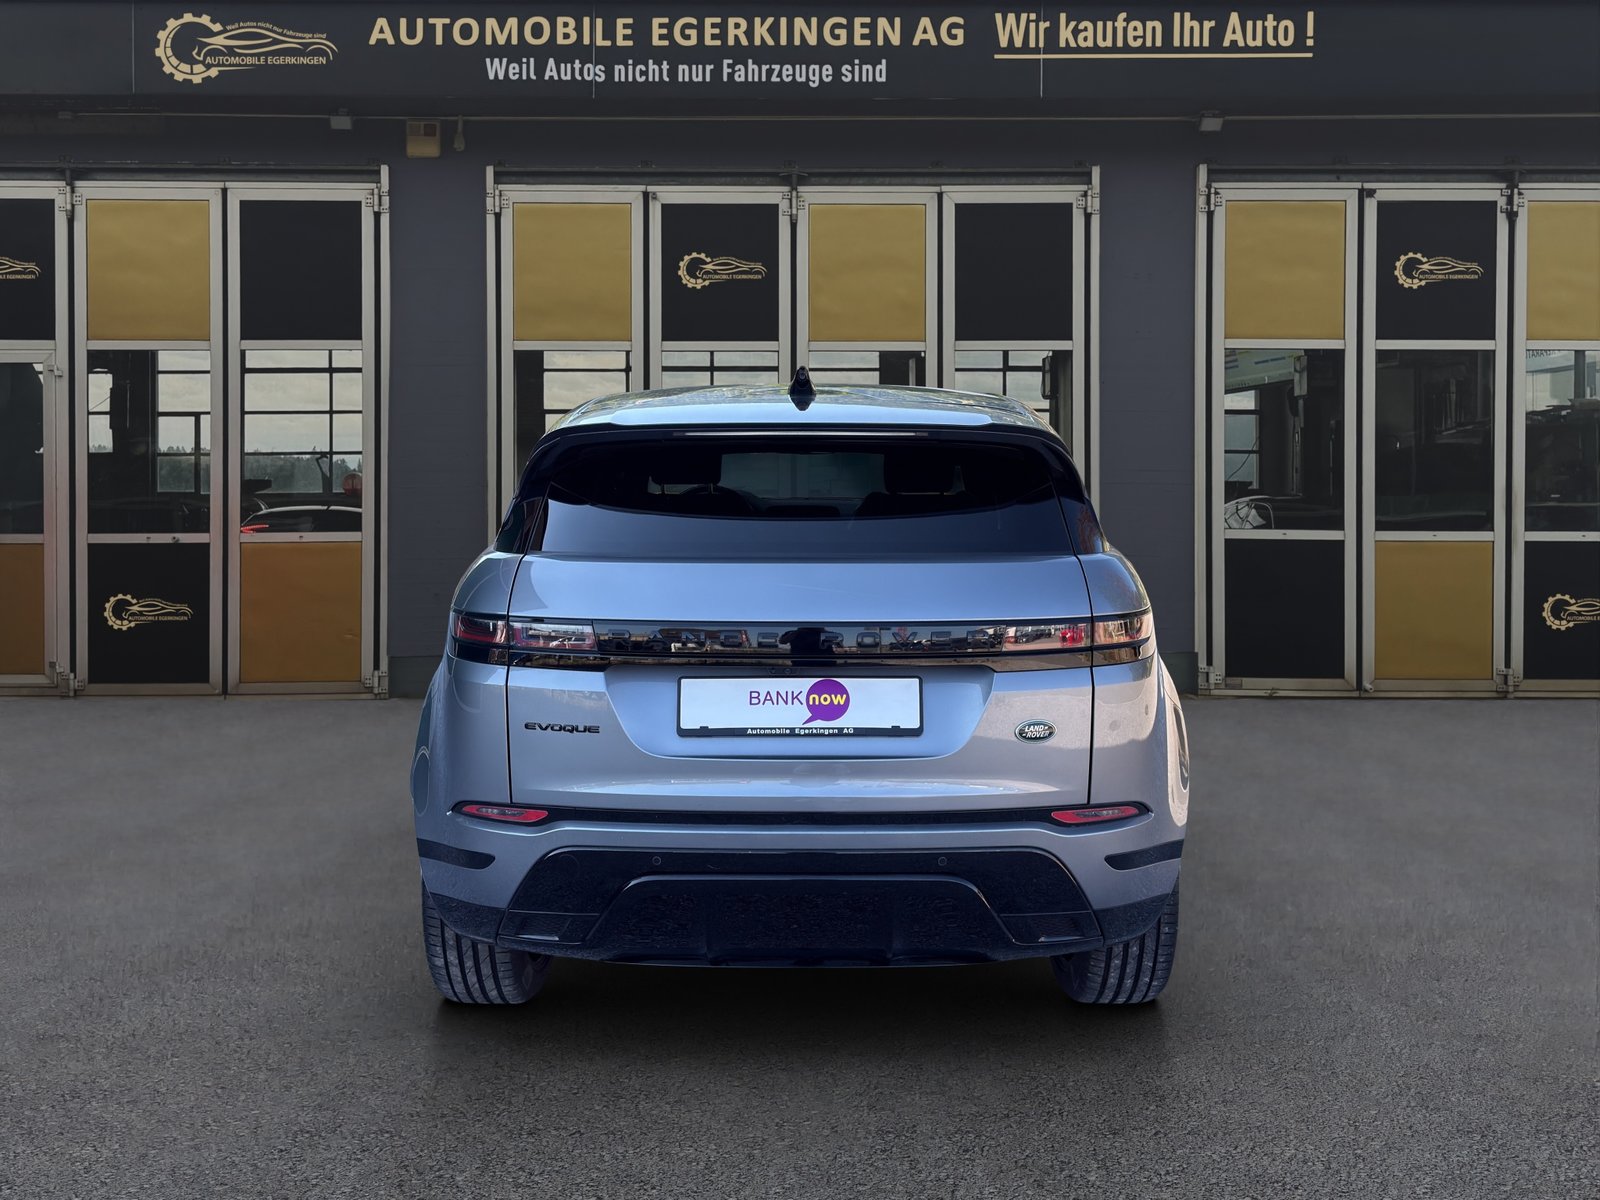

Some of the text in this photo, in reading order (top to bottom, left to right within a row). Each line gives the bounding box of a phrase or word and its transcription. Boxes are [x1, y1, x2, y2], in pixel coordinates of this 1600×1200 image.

[225, 22, 239, 31] Weil
[257, 21, 273, 30] nicht
[272, 26, 283, 34] nur
[283, 29, 313, 39] Fahrzeuge
[368, 16, 965, 47] AUTOMOBILE EGERKINGEN AG
[994, 11, 1315, 48] Wir kaufen Ihr Auto !
[205, 56, 327, 65] AUTOMOBILE EGERKINGEN
[485, 57, 887, 88] Weil Autos nicht nur Fahrzeuge sind
[748, 690, 847, 706] BANK now
[524, 721, 601, 734] EVOQUE
[794, 728, 839, 736] Egerkingen
